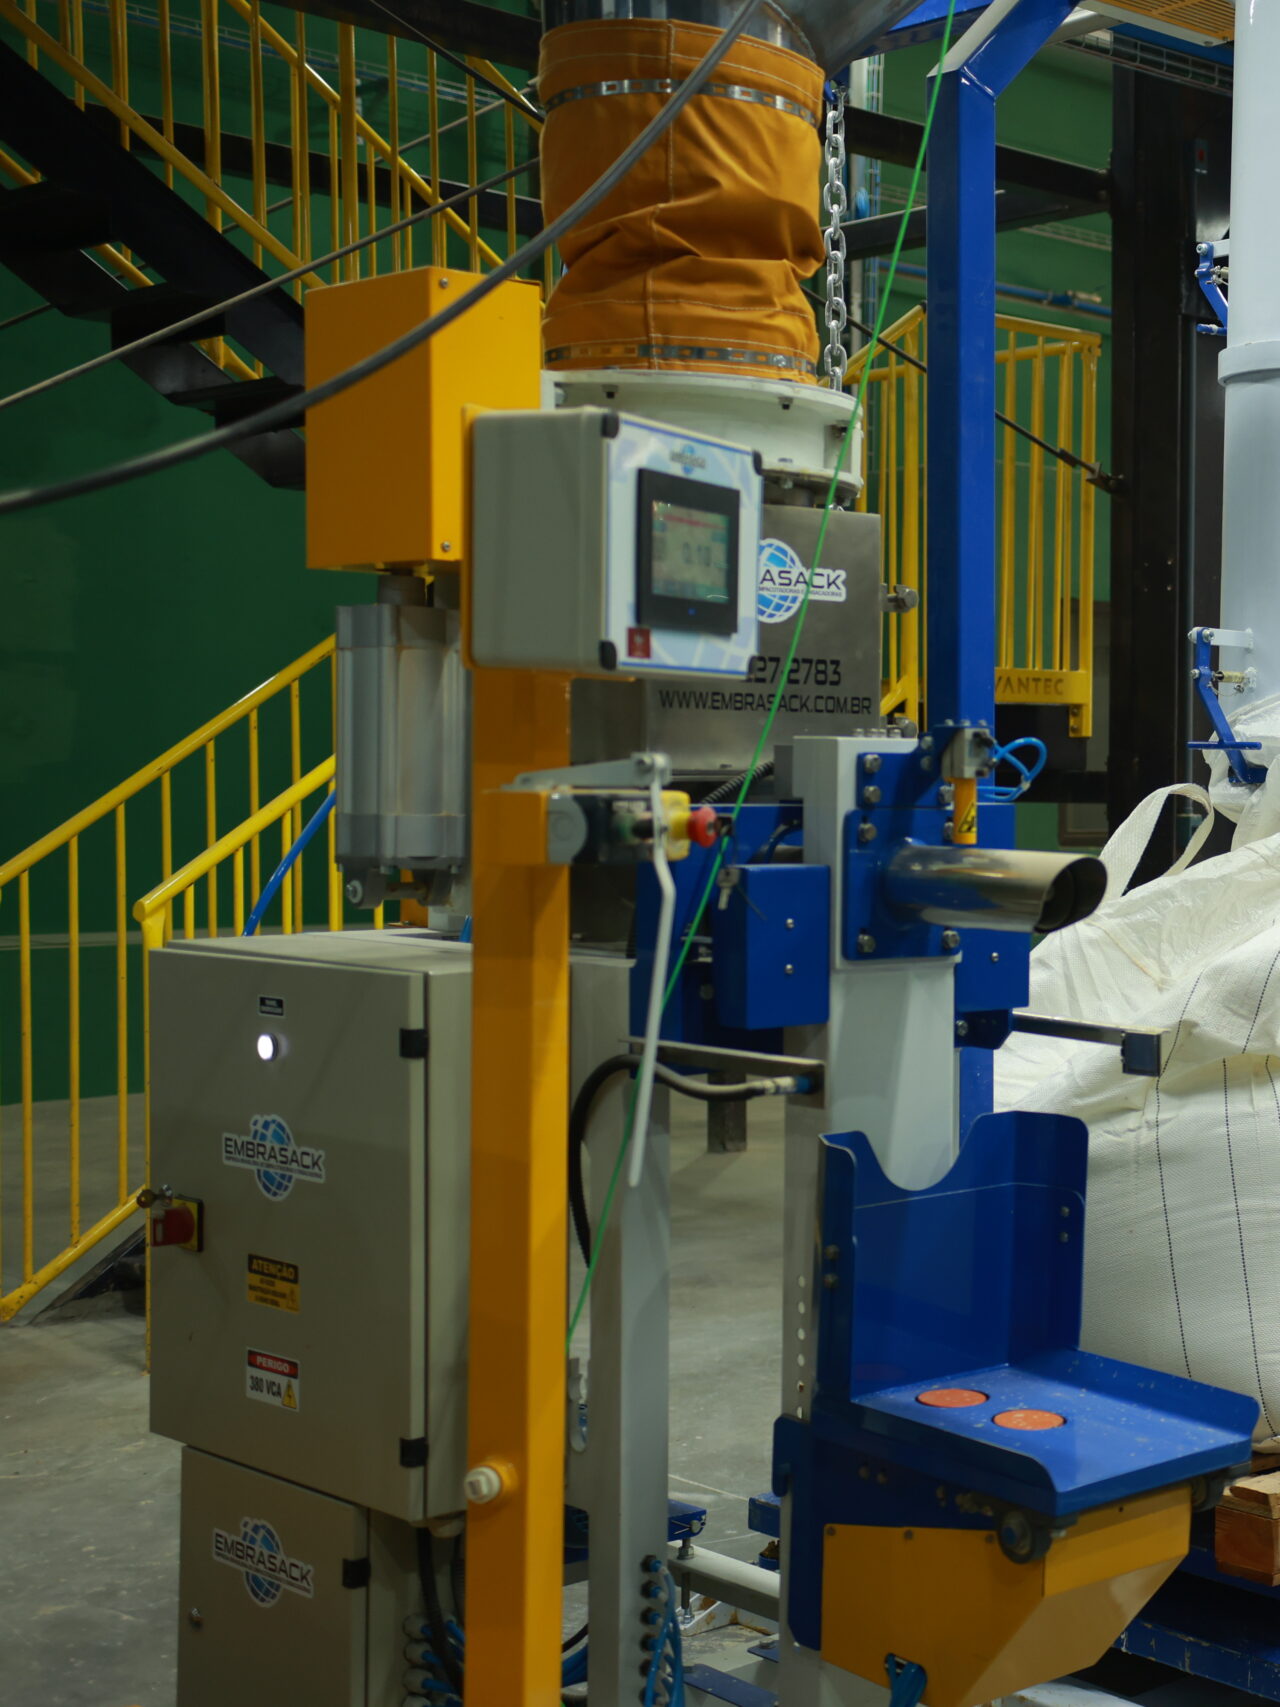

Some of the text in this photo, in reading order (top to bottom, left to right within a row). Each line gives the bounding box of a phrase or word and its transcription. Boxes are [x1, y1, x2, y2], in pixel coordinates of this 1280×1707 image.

[658, 689, 872, 715] WWW.EMBRASACK.COM.BR
[224, 1136, 323, 1172] EMBRASACK
[251, 1257, 296, 1281] ATENÇÃO
[256, 1355, 290, 1374] PERIGO
[249, 1374, 283, 1399] 380 VCA
[214, 1532, 312, 1587] EMBRASACK
